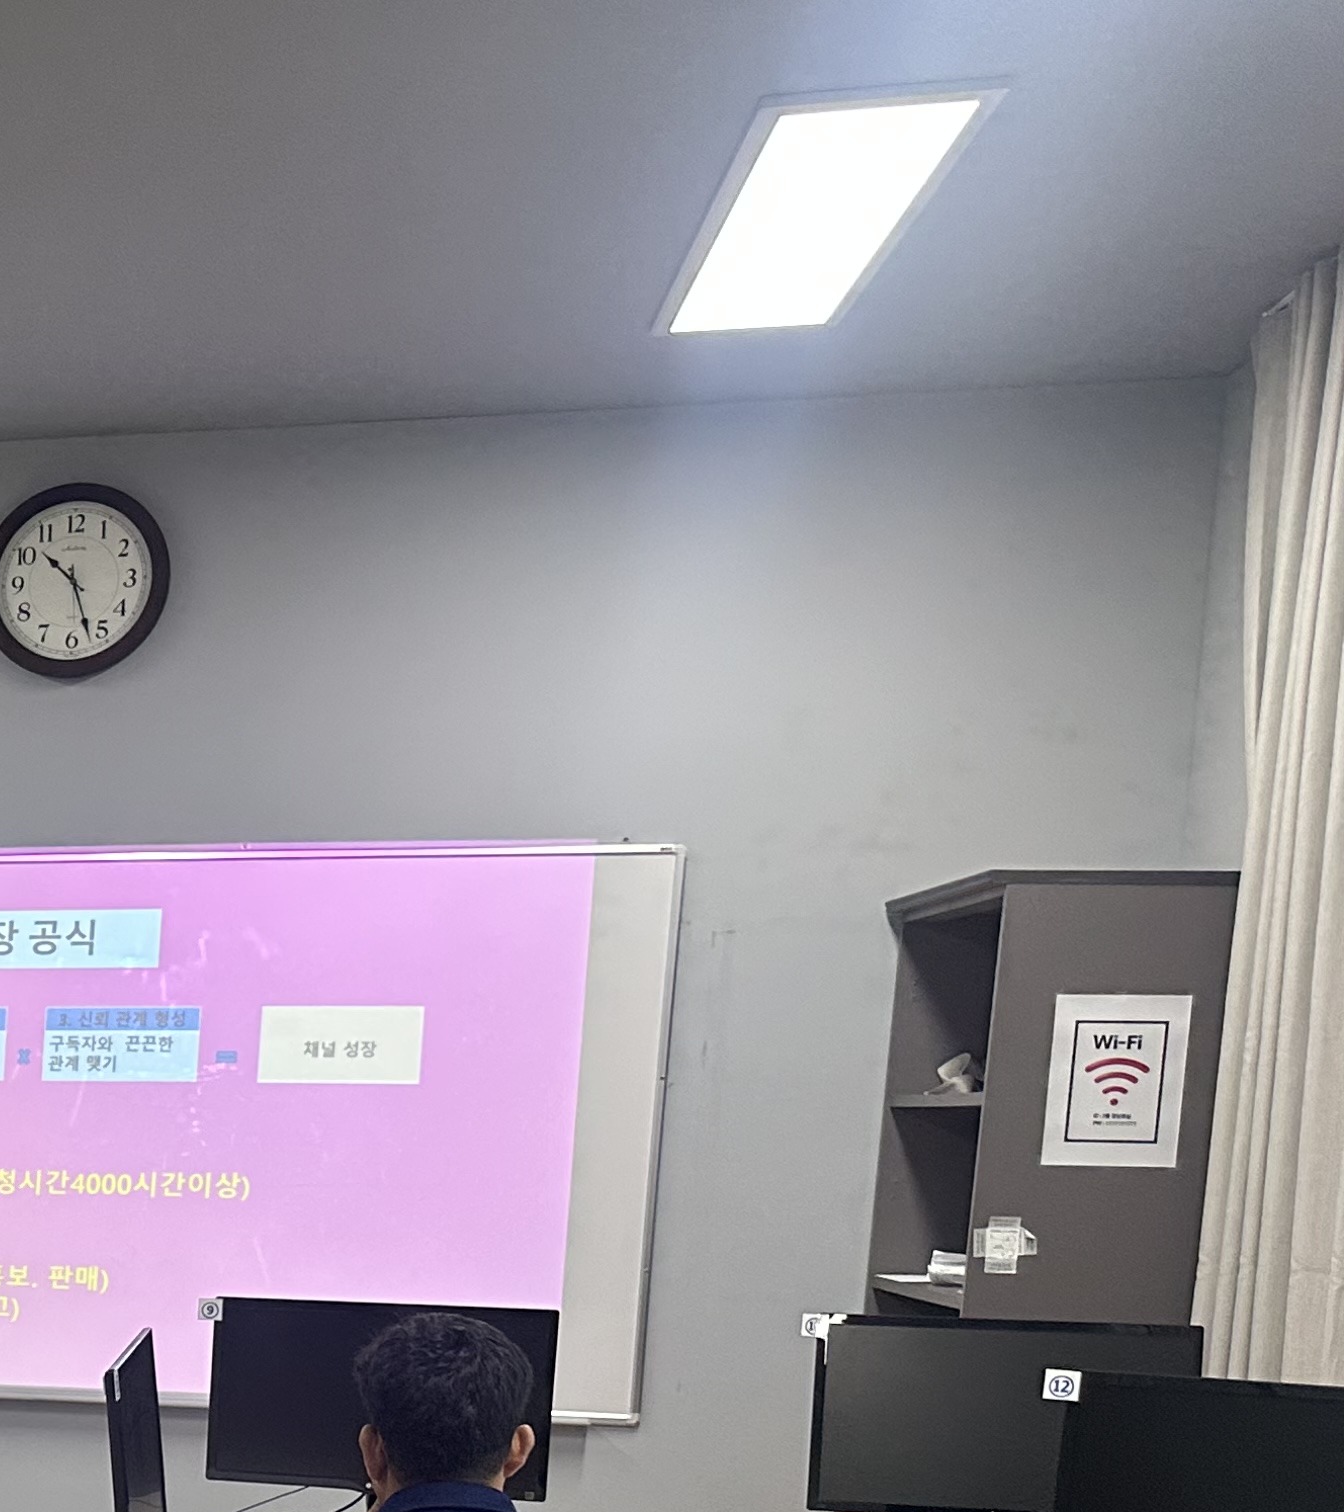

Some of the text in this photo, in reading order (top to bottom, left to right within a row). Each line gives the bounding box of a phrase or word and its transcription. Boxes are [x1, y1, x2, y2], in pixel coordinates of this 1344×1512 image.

[39, 523, 53, 543] 11
[67, 514, 86, 533] 12
[100, 520, 107, 539] 1
[17, 546, 36, 565] 10
[118, 538, 130, 557] 2
[11, 576, 25, 595] 9
[123, 568, 137, 588] 3
[16, 602, 31, 622] 8
[113, 598, 126, 616] 4
[38, 624, 50, 643] 7
[95, 620, 109, 639] 5
[65, 630, 78, 649] 6
[29, 919, 97, 956] 공식
[116, 1010, 147, 1027] 관계
[49, 1035, 174, 1053] 구독자와 끈끈한
[303, 1041, 377, 1059] 채널 성장
[1093, 1035, 1143, 1050] Wi-Fi
[48, 1055, 117, 1073] 관계 맺기
[48, 1264, 110, 1295] 판매)
